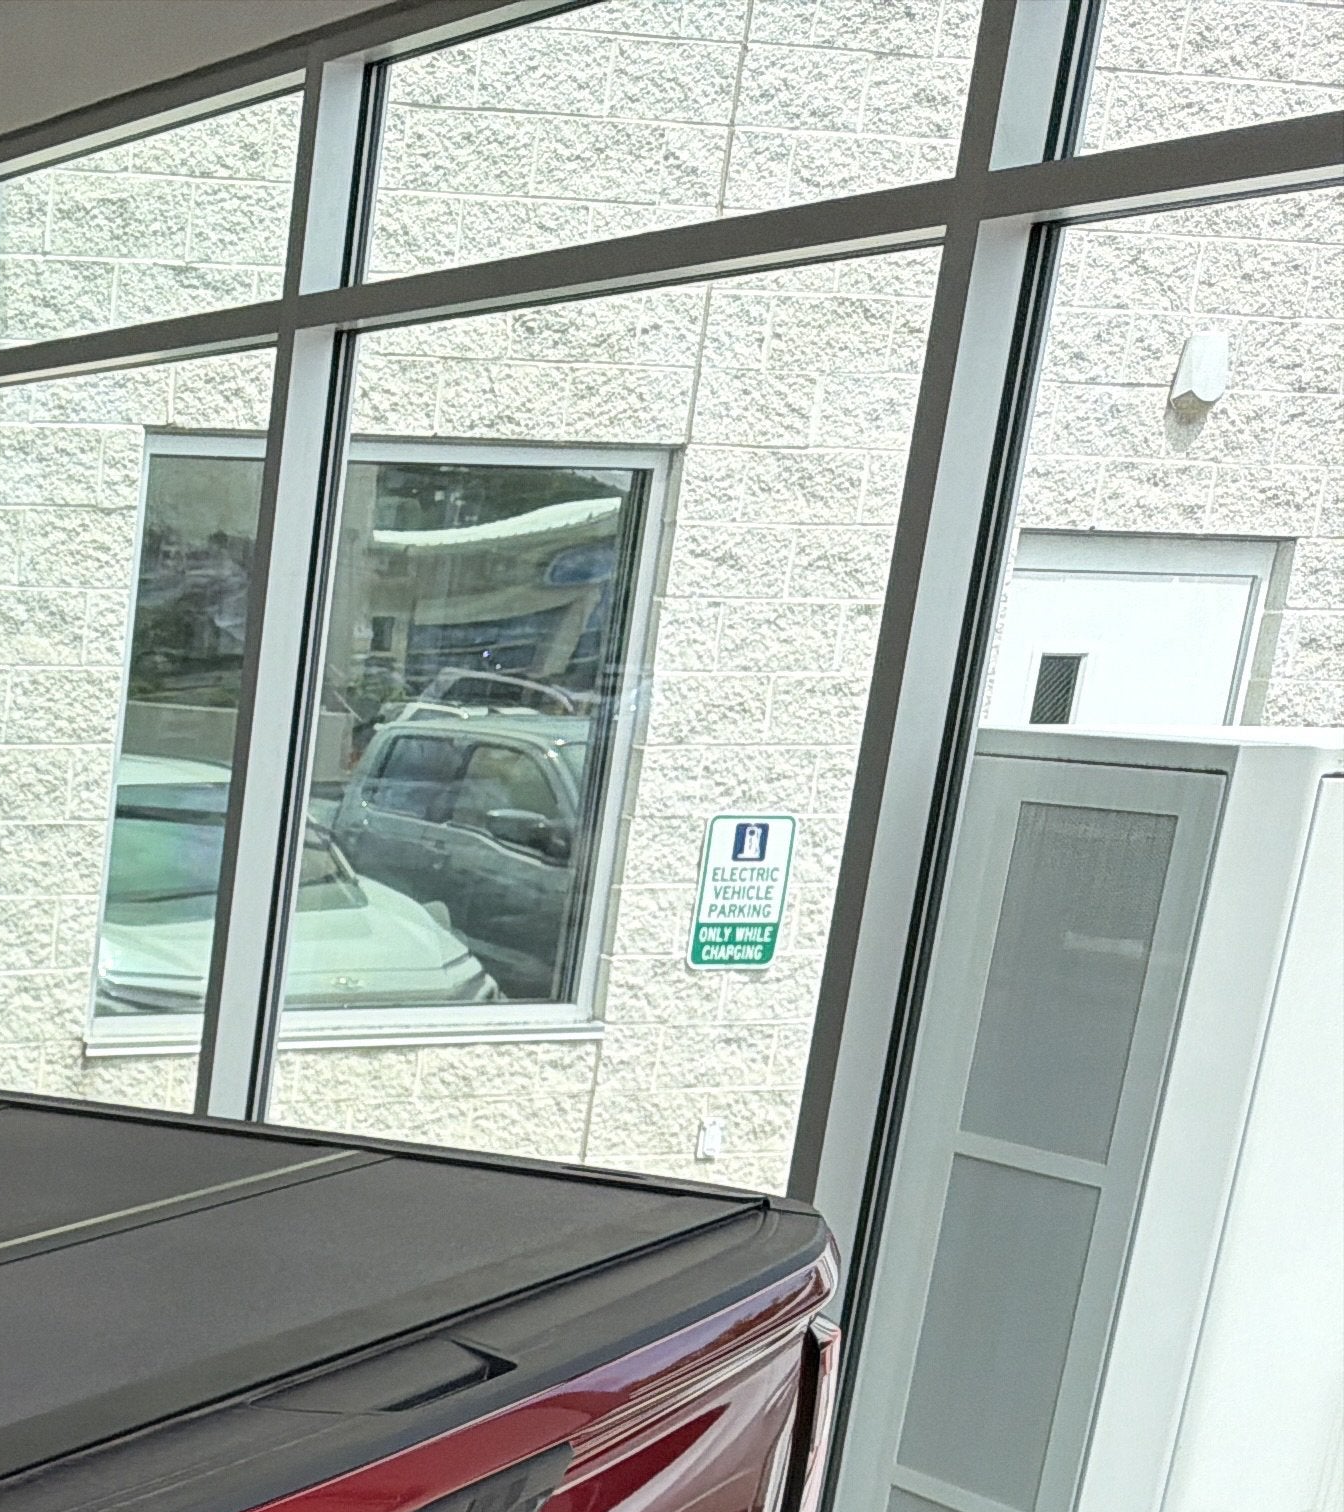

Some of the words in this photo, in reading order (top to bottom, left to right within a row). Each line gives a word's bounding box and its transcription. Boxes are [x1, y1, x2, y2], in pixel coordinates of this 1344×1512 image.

[712, 867, 780, 882] ELECTRIC
[714, 885, 774, 900] VEHICLE
[707, 904, 772, 918] PARKING
[699, 926, 732, 942] ONLY
[735, 926, 773, 942] WHILE
